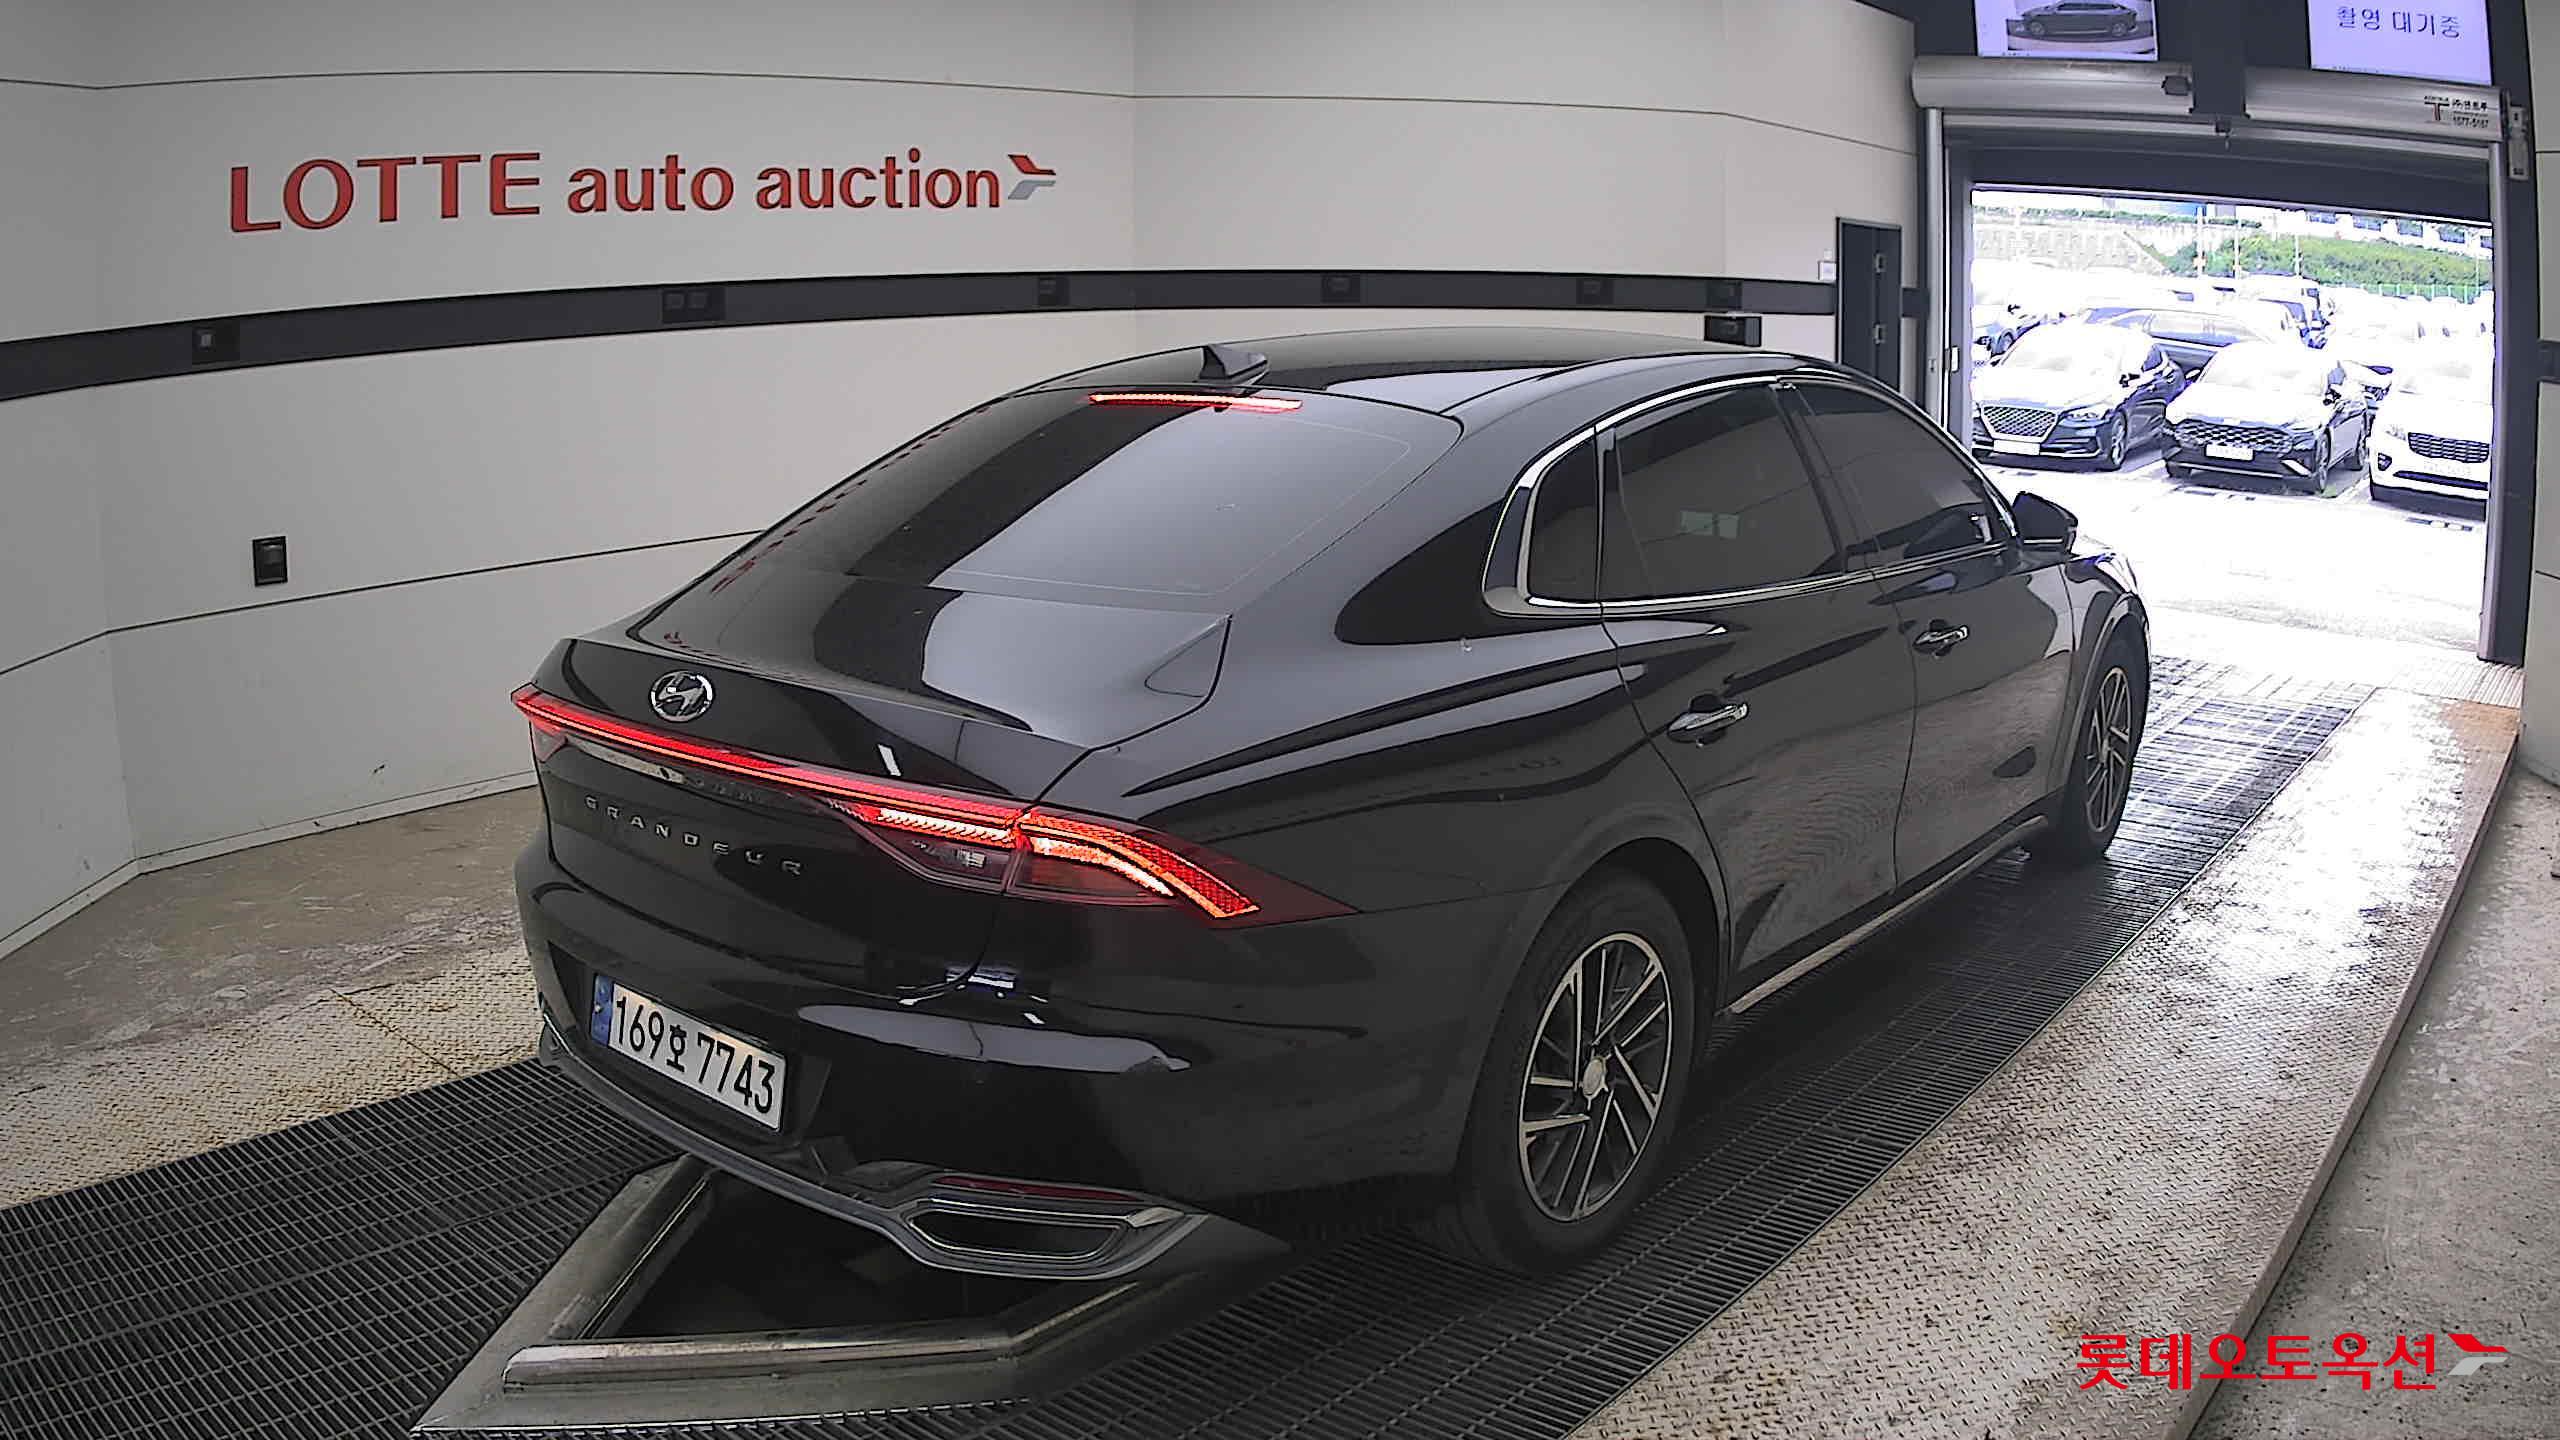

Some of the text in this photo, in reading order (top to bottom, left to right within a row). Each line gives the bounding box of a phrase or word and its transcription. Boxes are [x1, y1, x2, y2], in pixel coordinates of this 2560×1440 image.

[2391, 10, 2460, 40] 대기중
[231, 148, 1003, 233] LOTTE auto auction
[583, 794, 802, 876] GRANDEUR
[615, 995, 777, 1114] 169호 7743
